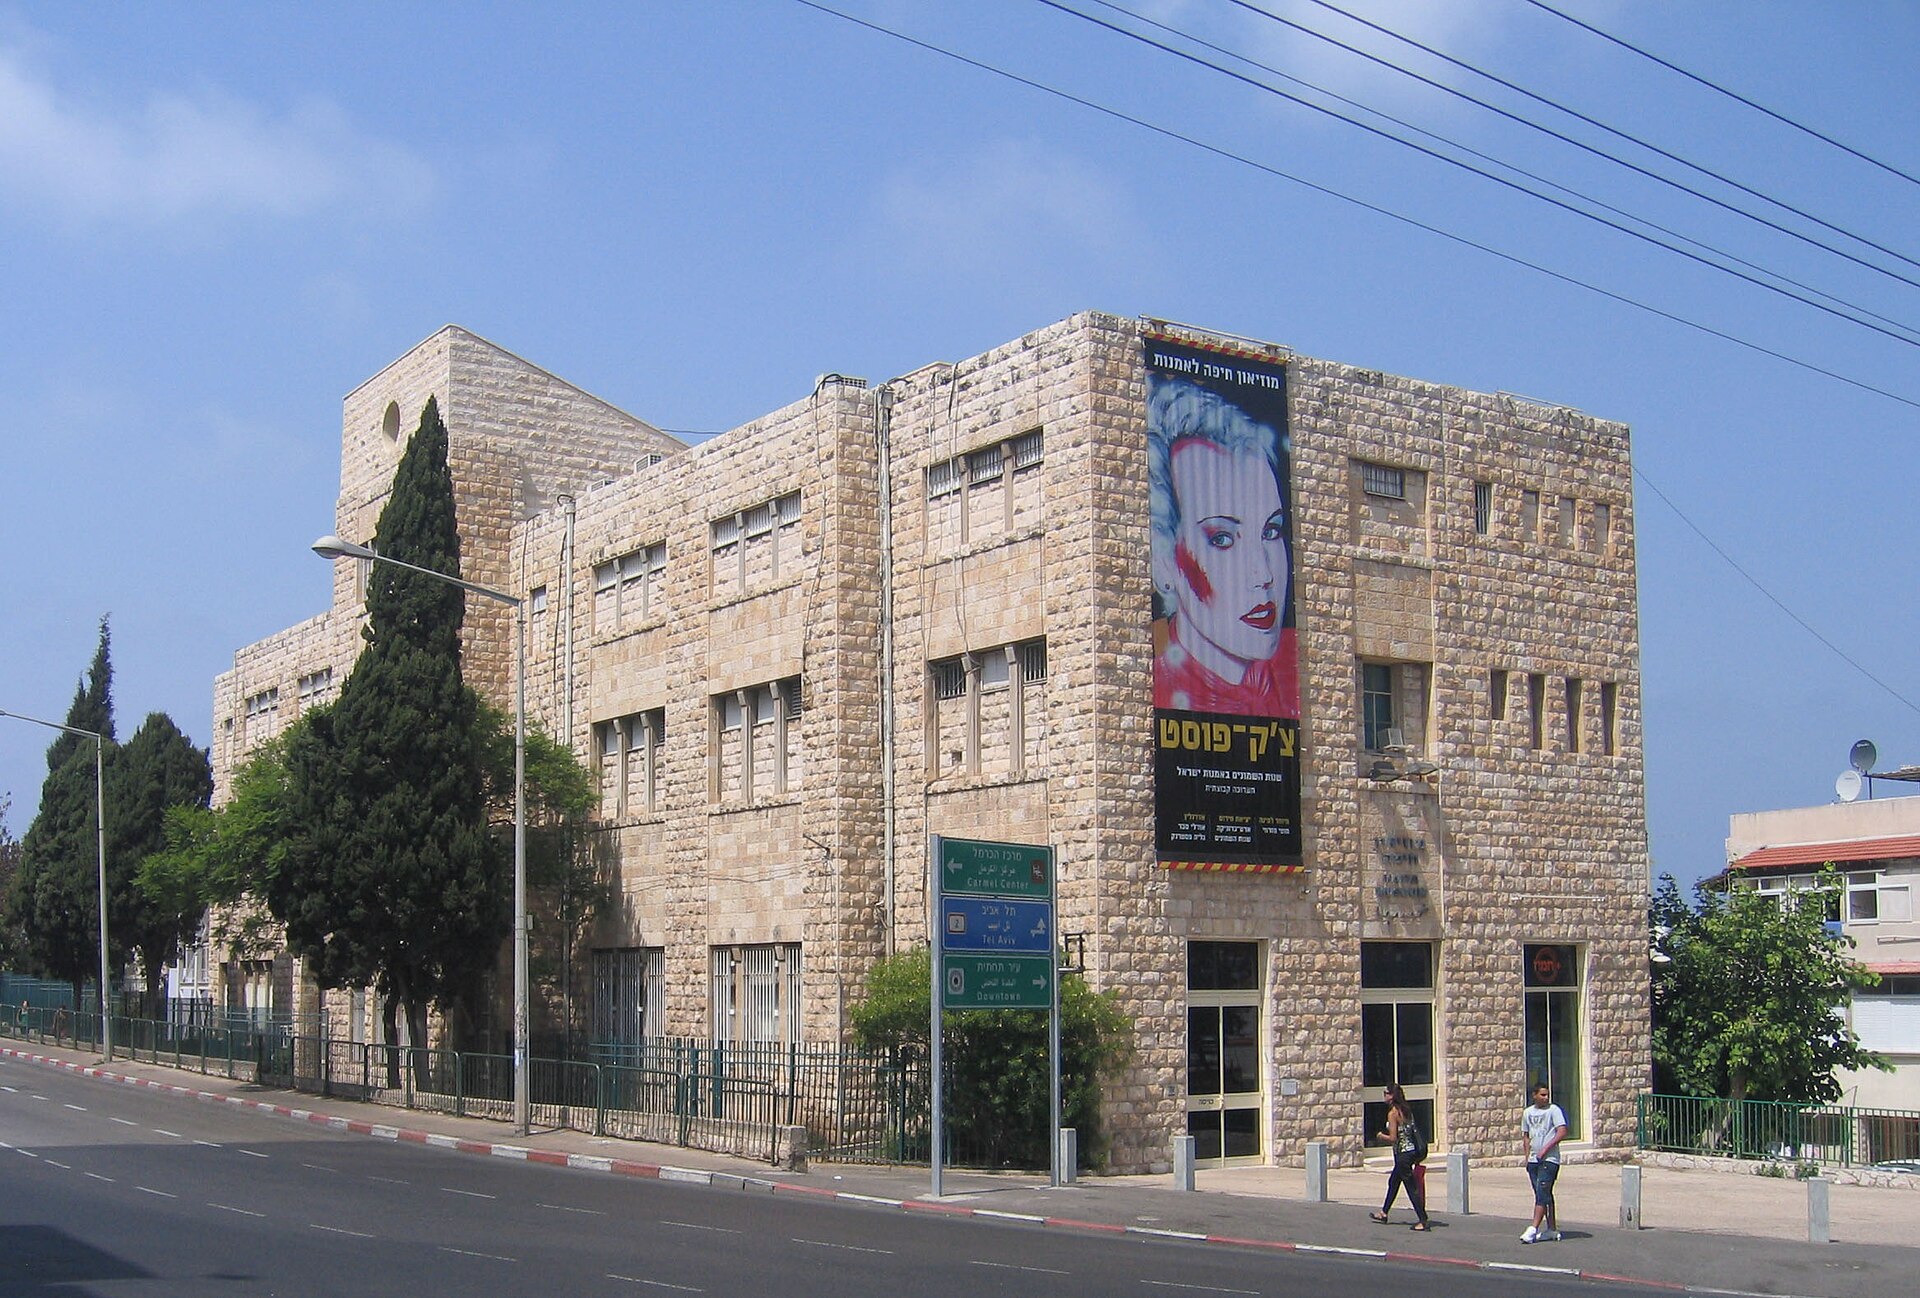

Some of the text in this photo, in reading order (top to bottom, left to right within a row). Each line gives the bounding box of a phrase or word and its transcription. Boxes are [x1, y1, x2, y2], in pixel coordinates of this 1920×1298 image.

[1154, 352, 1279, 389] מוזיאון חיפה לאמנות
[1177, 766, 1201, 776] ישראל
[1204, 770, 1230, 779] באמנות
[1232, 771, 1263, 781] השמונים
[973, 847, 1022, 861] מרכז הכרמל
[967, 878, 1029, 890] Carmel Center
[982, 905, 1016, 916] תל אביב
[982, 935, 1016, 945] Tel Aviv
[977, 962, 1021, 973] עיר תחתית
[977, 991, 1021, 1001] Downtown
